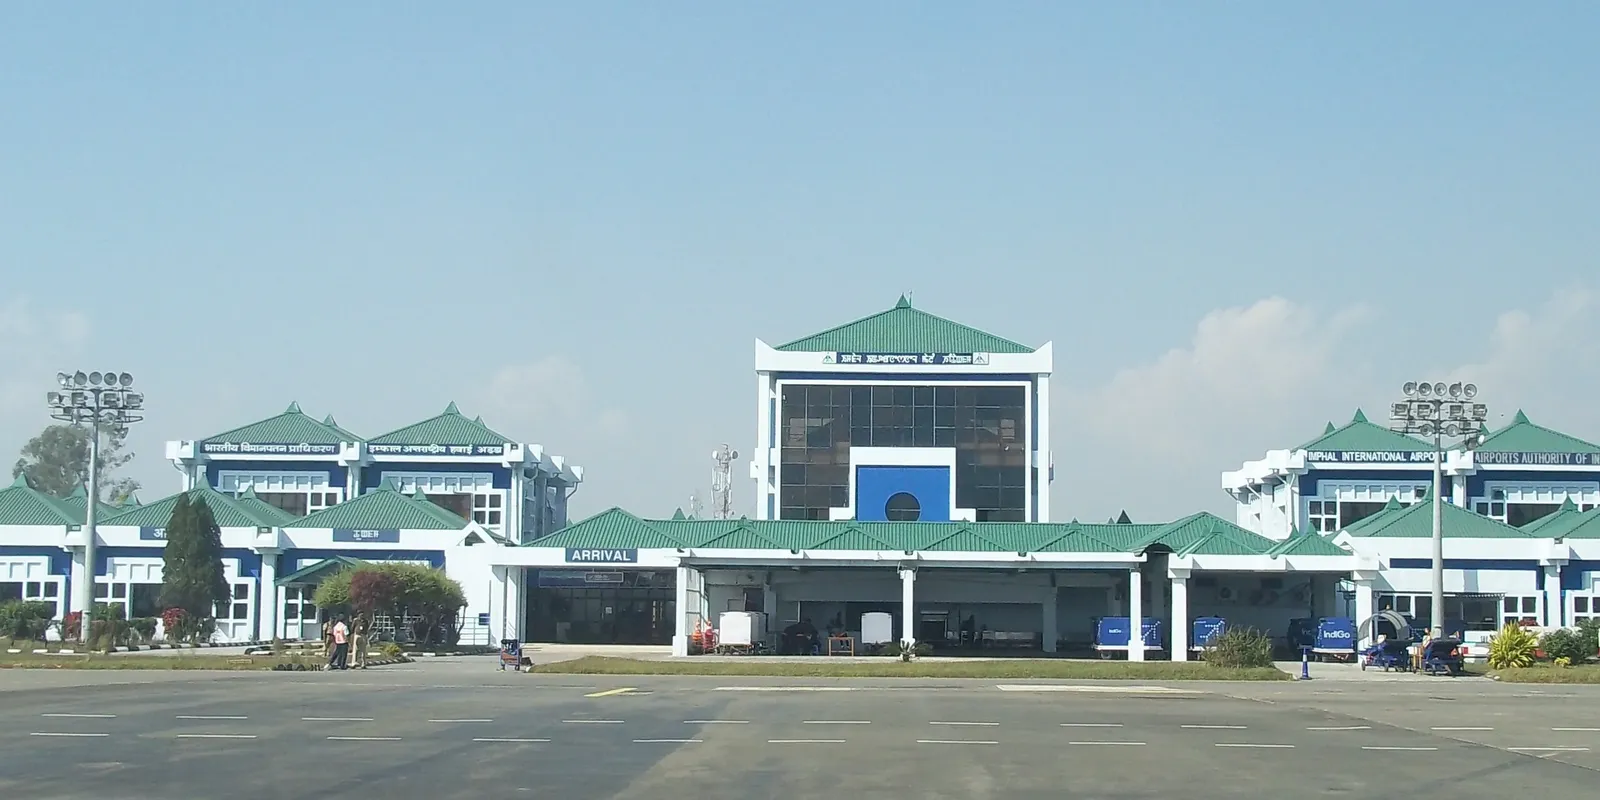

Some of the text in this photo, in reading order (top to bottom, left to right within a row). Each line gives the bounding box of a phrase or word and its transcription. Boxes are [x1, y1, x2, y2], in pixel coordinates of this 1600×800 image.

[204, 442, 335, 453] भारतीय विमानपतन प्राधिकरण
[369, 444, 401, 454] इम्फाल
[1308, 451, 1446, 461] IMPHAL INTERNATIONAL AIRPOT
[1475, 452, 1519, 463] AIRPORTS
[1521, 452, 1571, 464] AUTHORITY
[1575, 453, 1587, 464] OF
[571, 549, 631, 561] ARRIVAL
[1323, 630, 1351, 639] IndiGo
